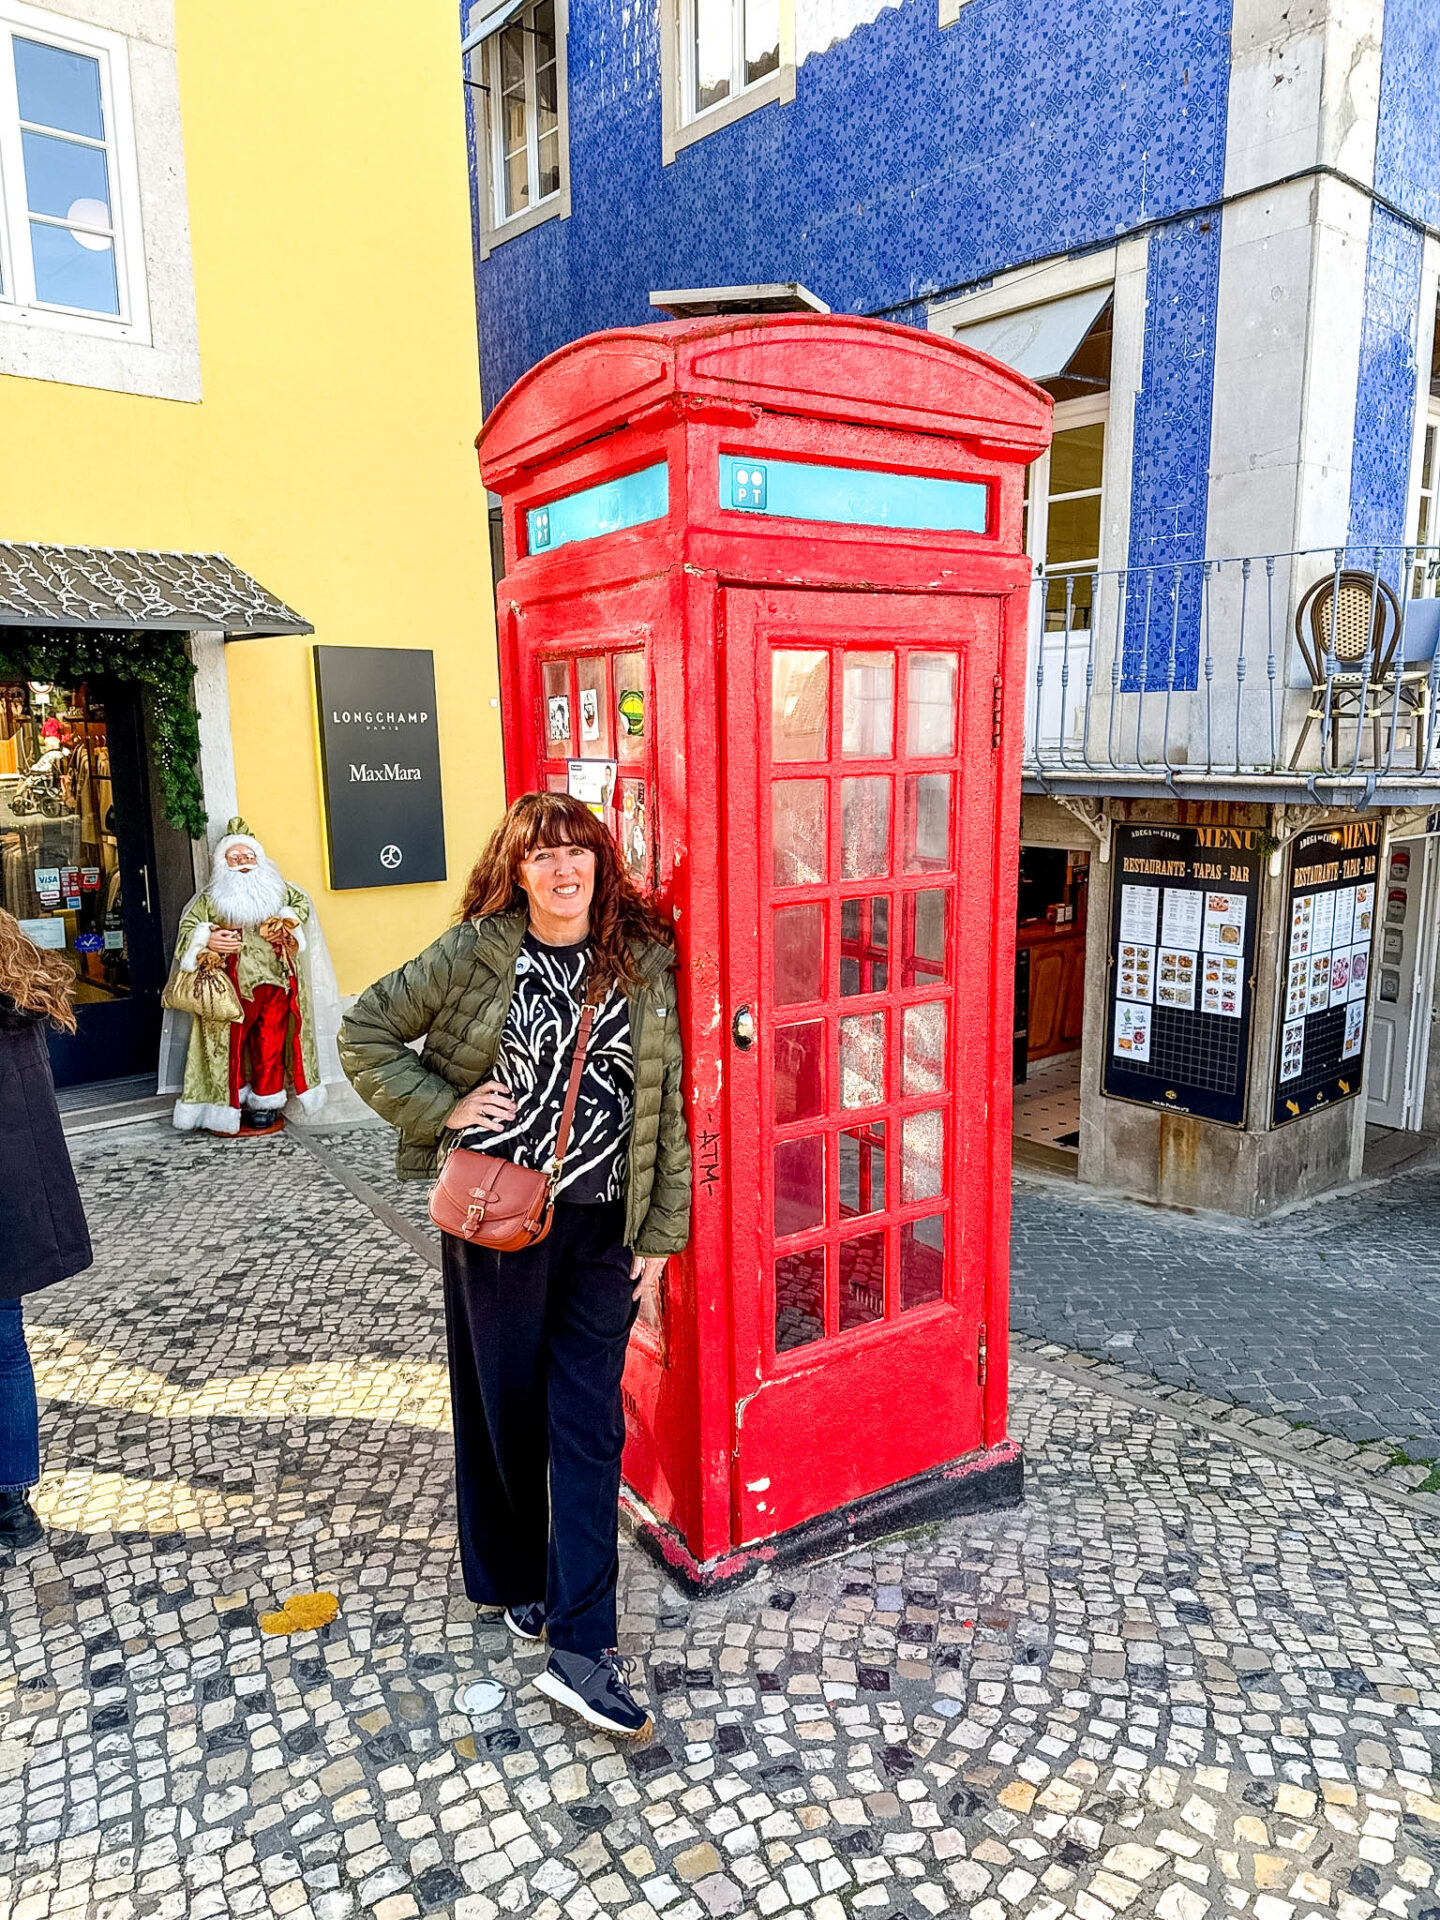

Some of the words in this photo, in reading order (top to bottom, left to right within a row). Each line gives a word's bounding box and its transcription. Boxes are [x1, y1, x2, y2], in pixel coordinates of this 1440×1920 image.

[738, 488, 762, 504] PT
[333, 711, 428, 724] LONGCHAMP
[348, 763, 422, 782] MaxMara
[1194, 827, 1258, 851] MENU
[1341, 822, 1379, 851] MENU
[1122, 857, 1186, 877] RESTAURANTE
[1193, 863, 1222, 880] TAPAS
[1229, 865, 1250, 883] BAR
[1293, 862, 1340, 888] RESTAURANTE
[1342, 858, 1361, 879] TAPAS
[1363, 855, 1376, 875] BAR
